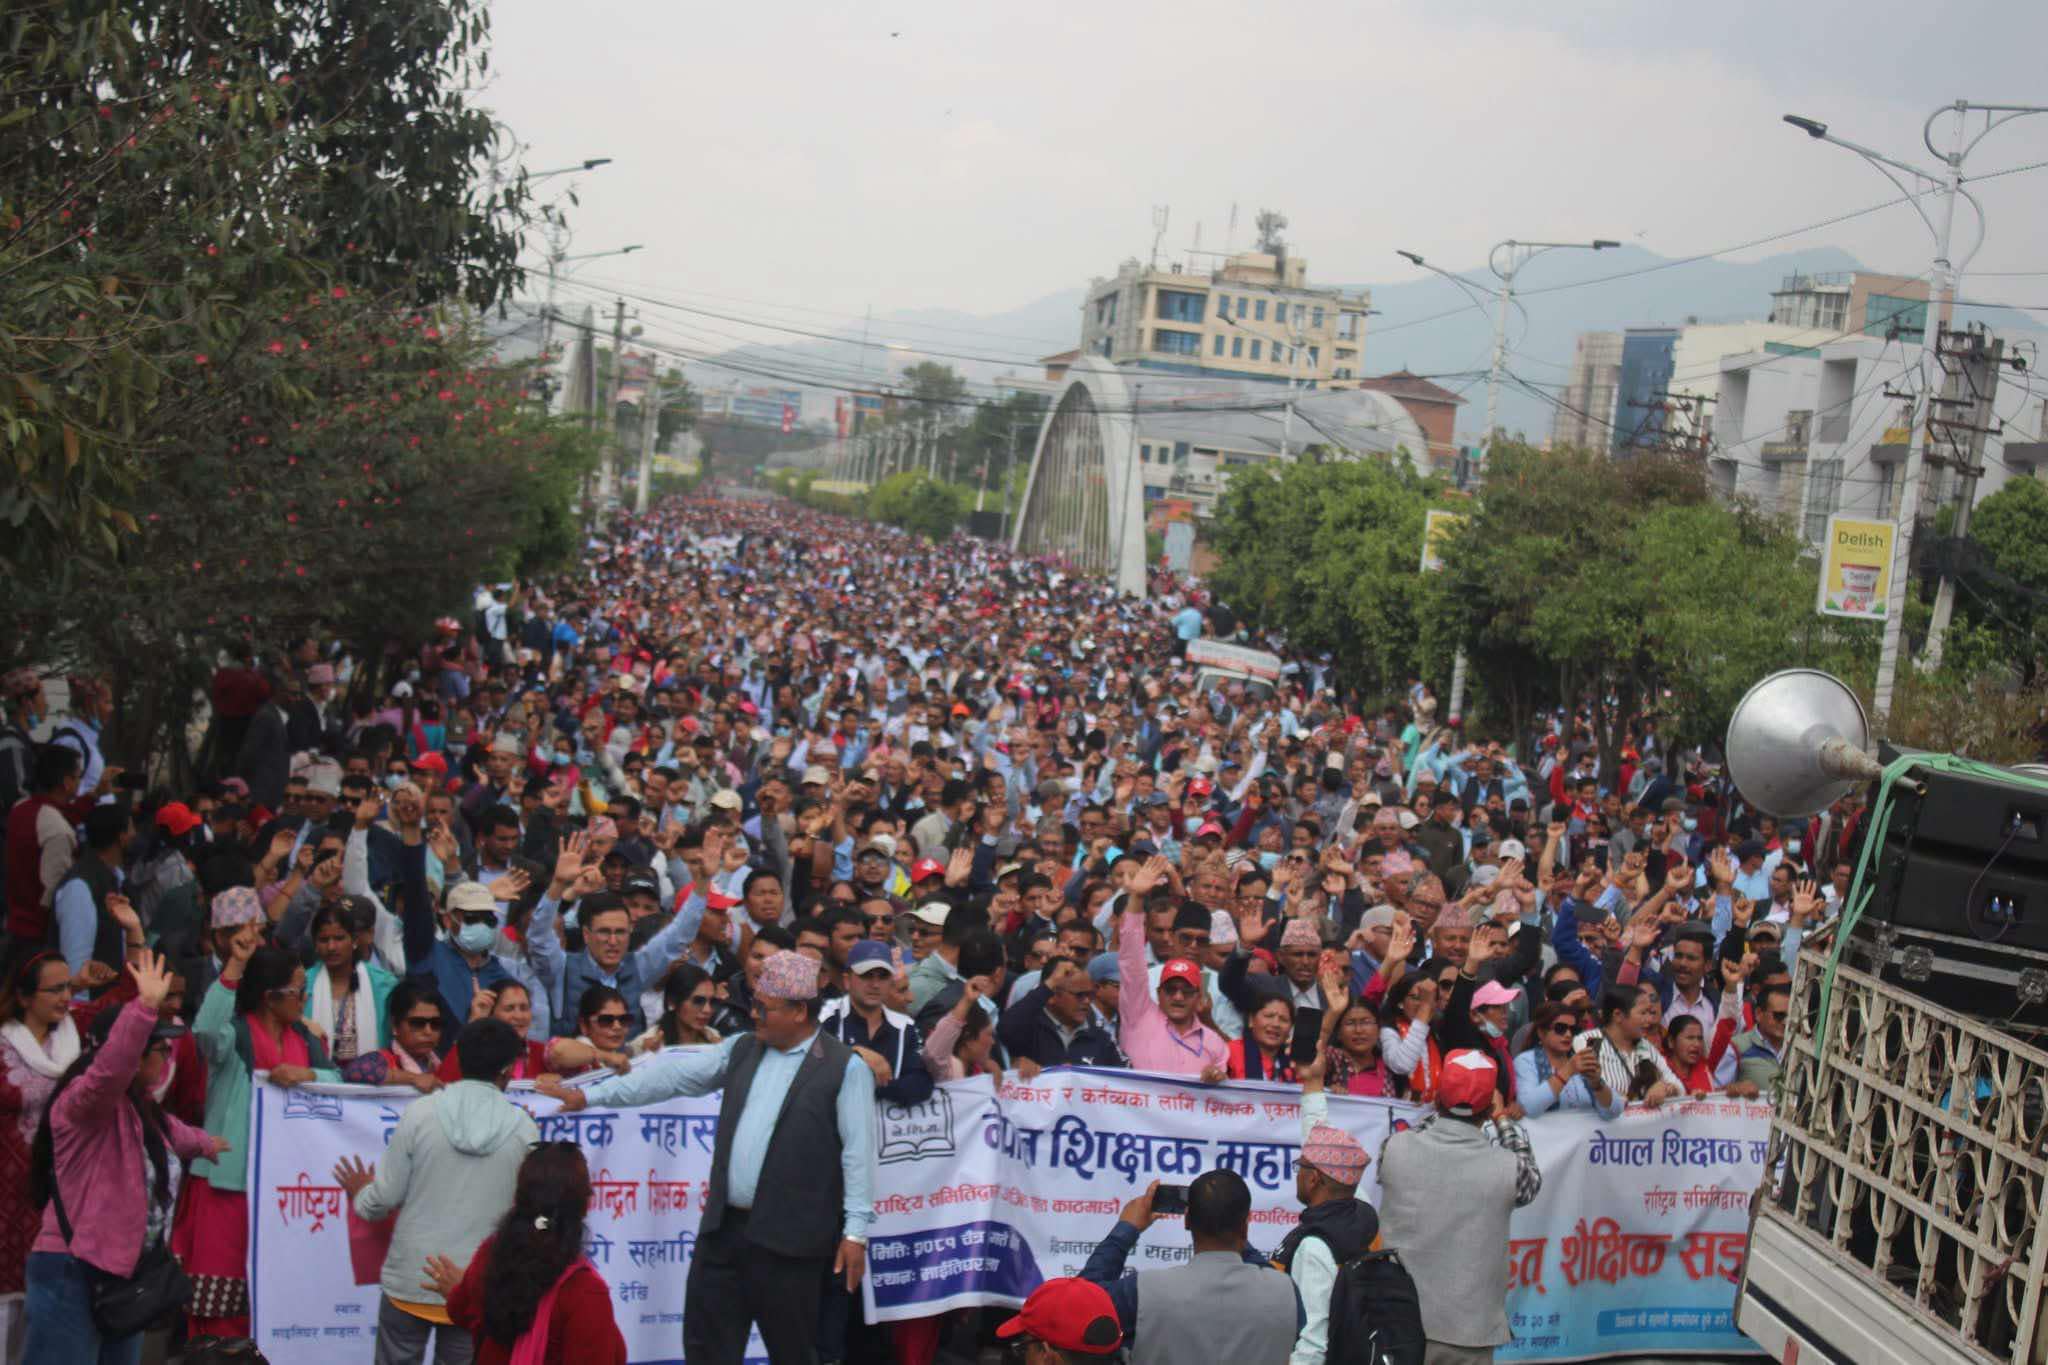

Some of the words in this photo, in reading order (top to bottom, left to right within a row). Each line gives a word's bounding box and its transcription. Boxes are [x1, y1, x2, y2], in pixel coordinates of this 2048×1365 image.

[1838, 531, 1884, 548] Delish
[1050, 1114, 1207, 1184] शिक्षक
[1589, 1129, 1655, 1167] नेपाल
[1661, 1128, 1742, 1168] शिक्षक
[1559, 1216, 1674, 1290] शैक्षिक
